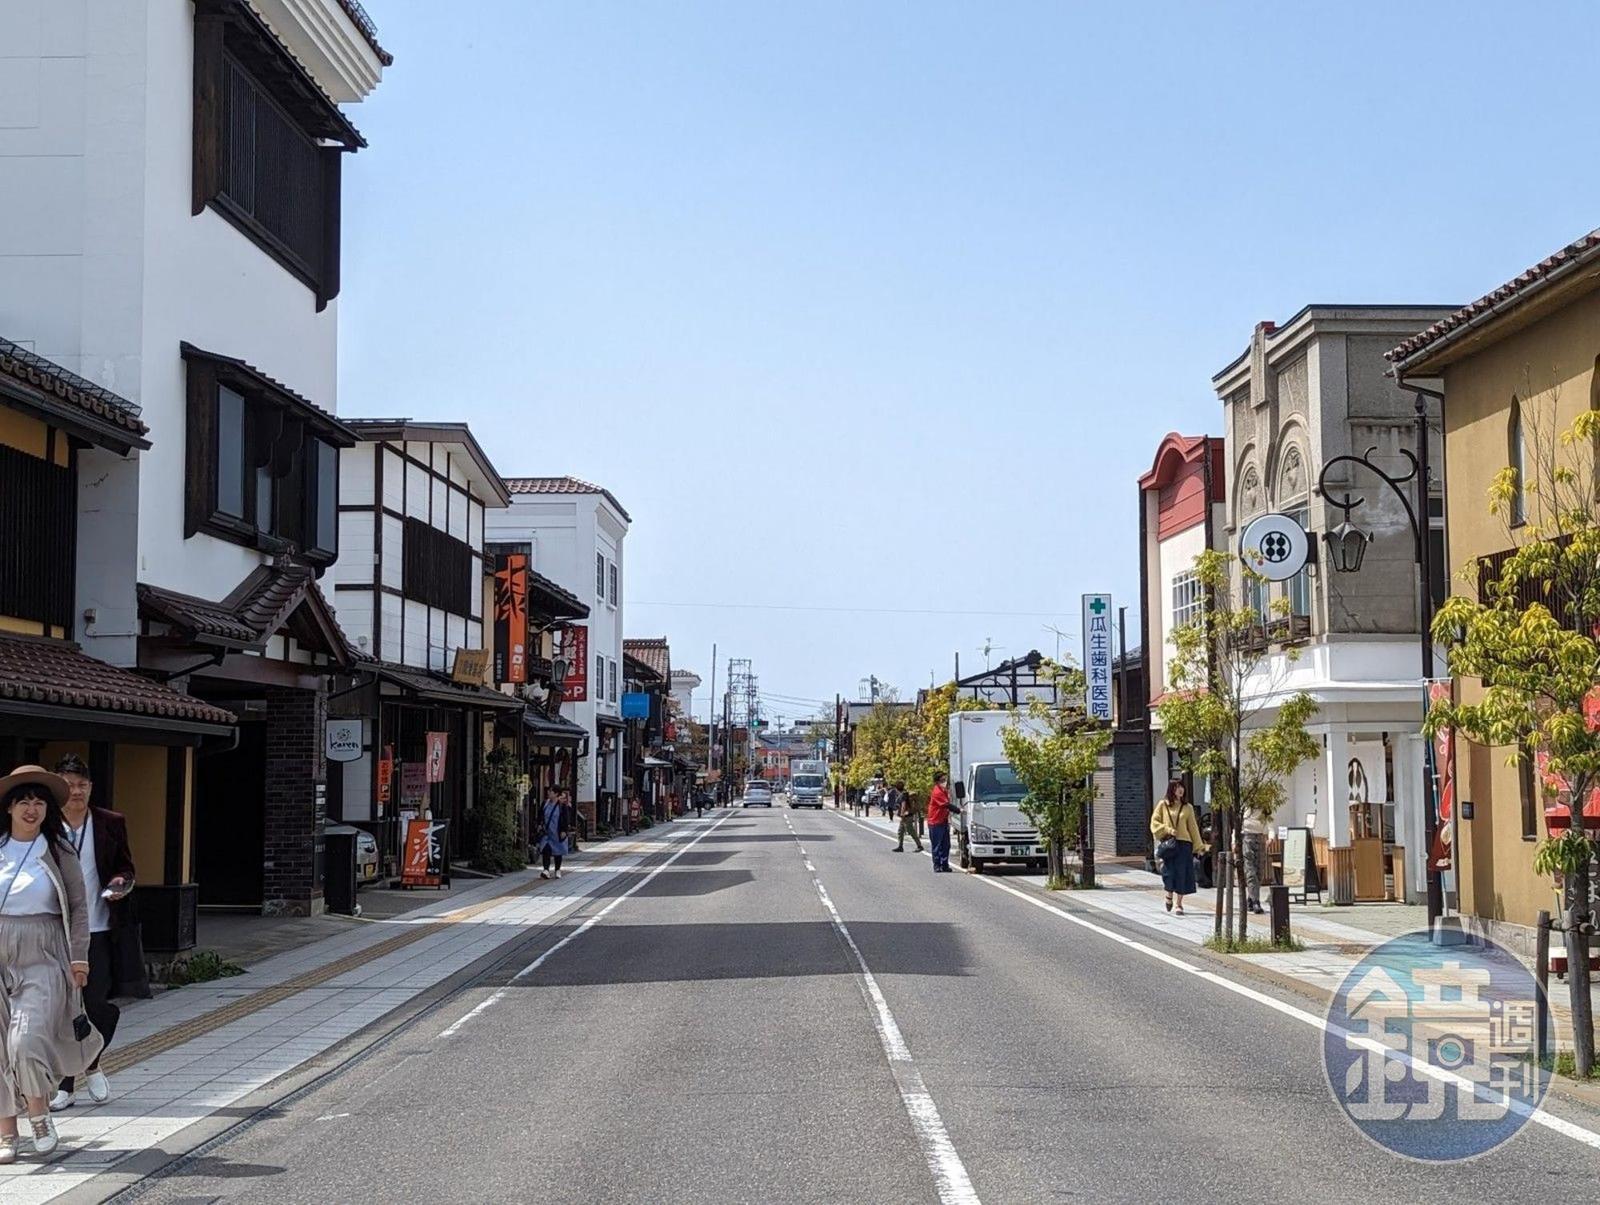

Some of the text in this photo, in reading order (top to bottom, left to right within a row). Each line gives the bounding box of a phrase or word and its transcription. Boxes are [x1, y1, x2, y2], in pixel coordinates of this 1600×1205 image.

[1090, 616, 1108, 718] 瓜生歯科医院
[573, 686, 585, 698] P
[411, 821, 446, 866] 漆
